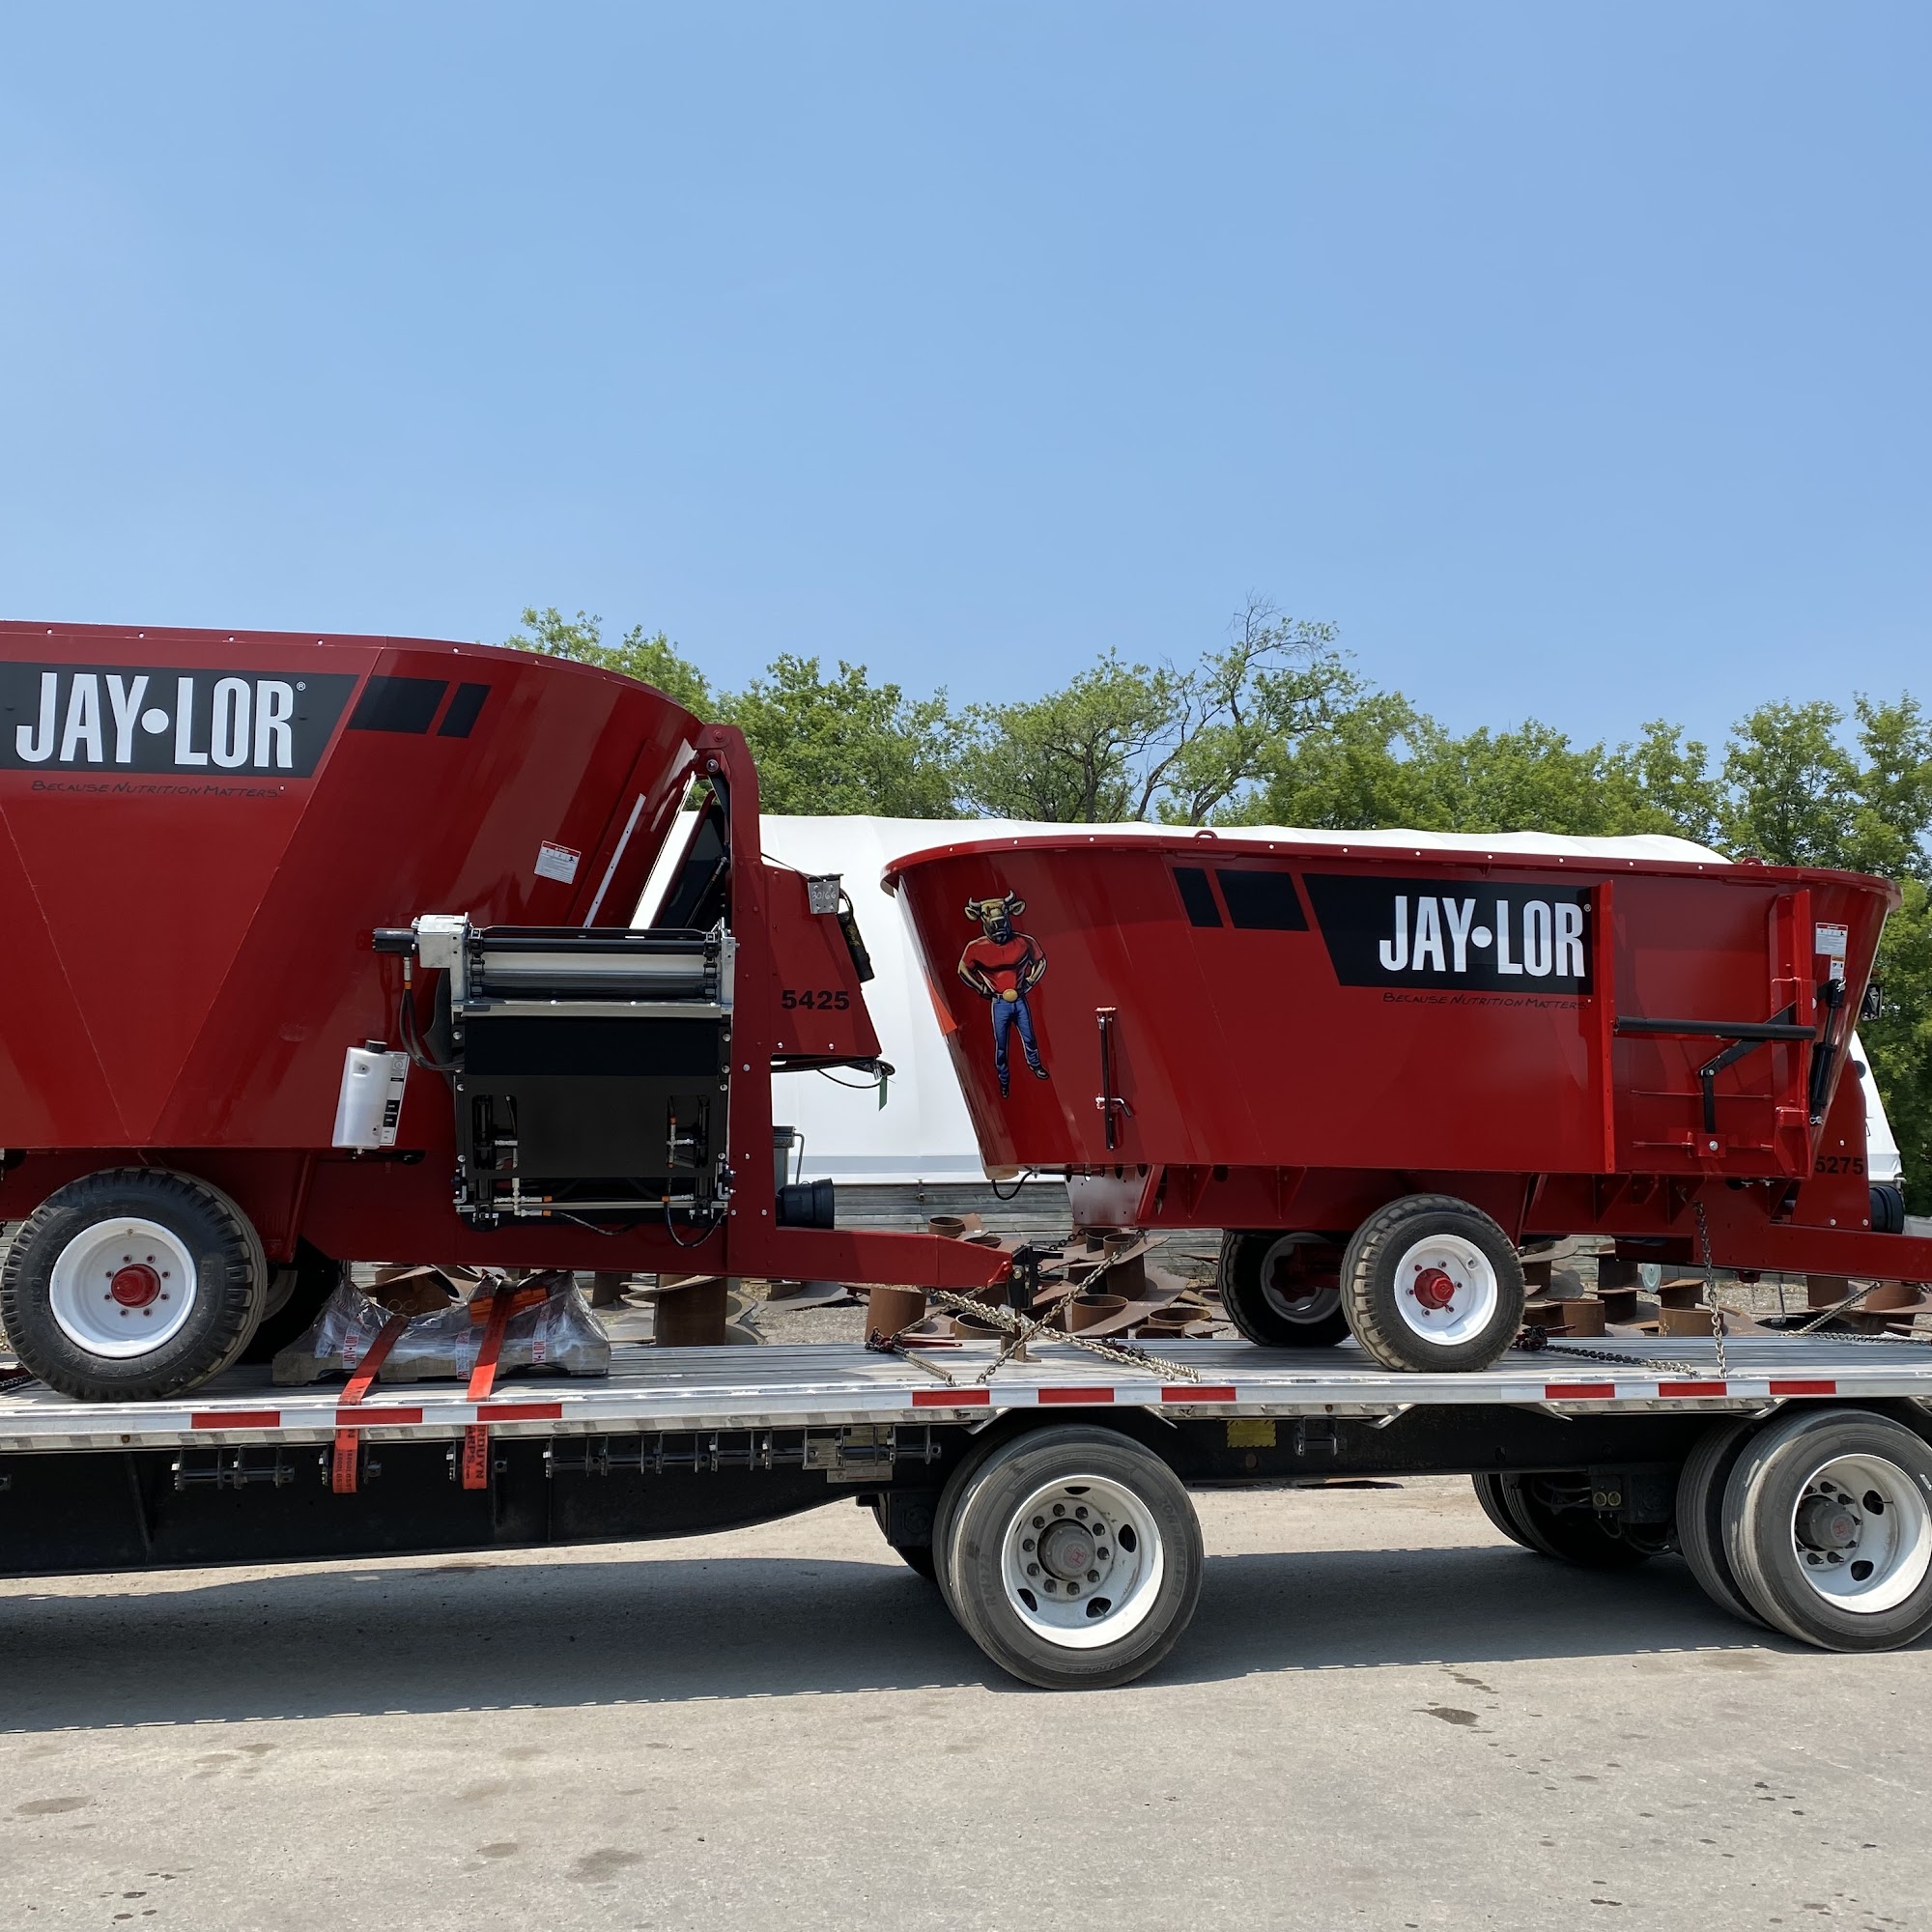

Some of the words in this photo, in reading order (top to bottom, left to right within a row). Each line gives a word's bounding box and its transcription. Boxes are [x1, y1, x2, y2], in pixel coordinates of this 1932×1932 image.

[31, 780, 109, 794] BECAUSE
[111, 781, 202, 796] NUTRITION
[781, 989, 850, 1010] 5425
[1382, 992, 1447, 1005] BECAUSE
[1448, 993, 1524, 1008] NUTRITION
[1814, 1155, 1864, 1176] 5275
